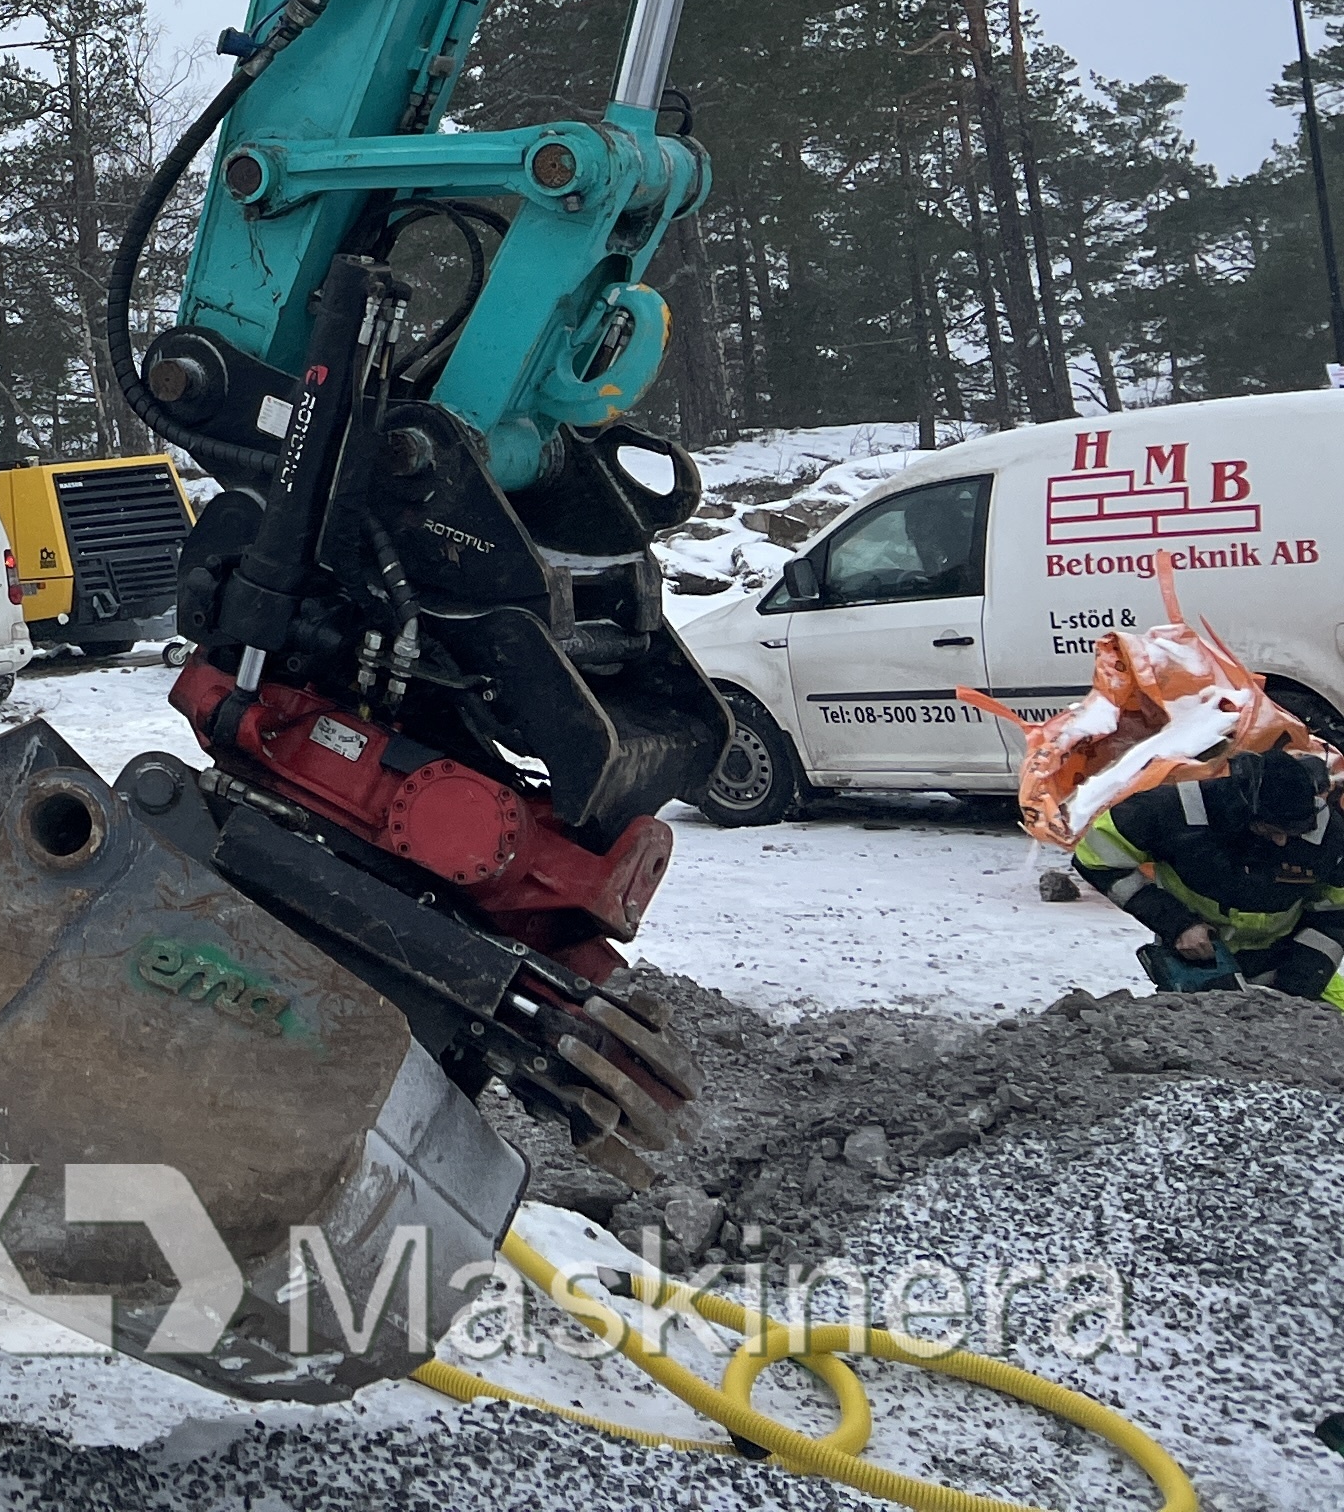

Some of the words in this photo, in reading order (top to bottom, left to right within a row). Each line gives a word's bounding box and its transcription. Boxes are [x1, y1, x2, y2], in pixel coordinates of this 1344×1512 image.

[421, 518, 496, 554] ROTOTILT
[1046, 542, 1262, 579] Betongeknik
[1271, 539, 1320, 566] AB
[1050, 608, 1114, 630] L-stöd
[1120, 608, 1137, 628] &
[1053, 636, 1096, 655] Entr
[819, 706, 852, 724] Tel:
[854, 705, 917, 724] 08-500
[922, 705, 956, 723] 320
[961, 705, 983, 723] 11
